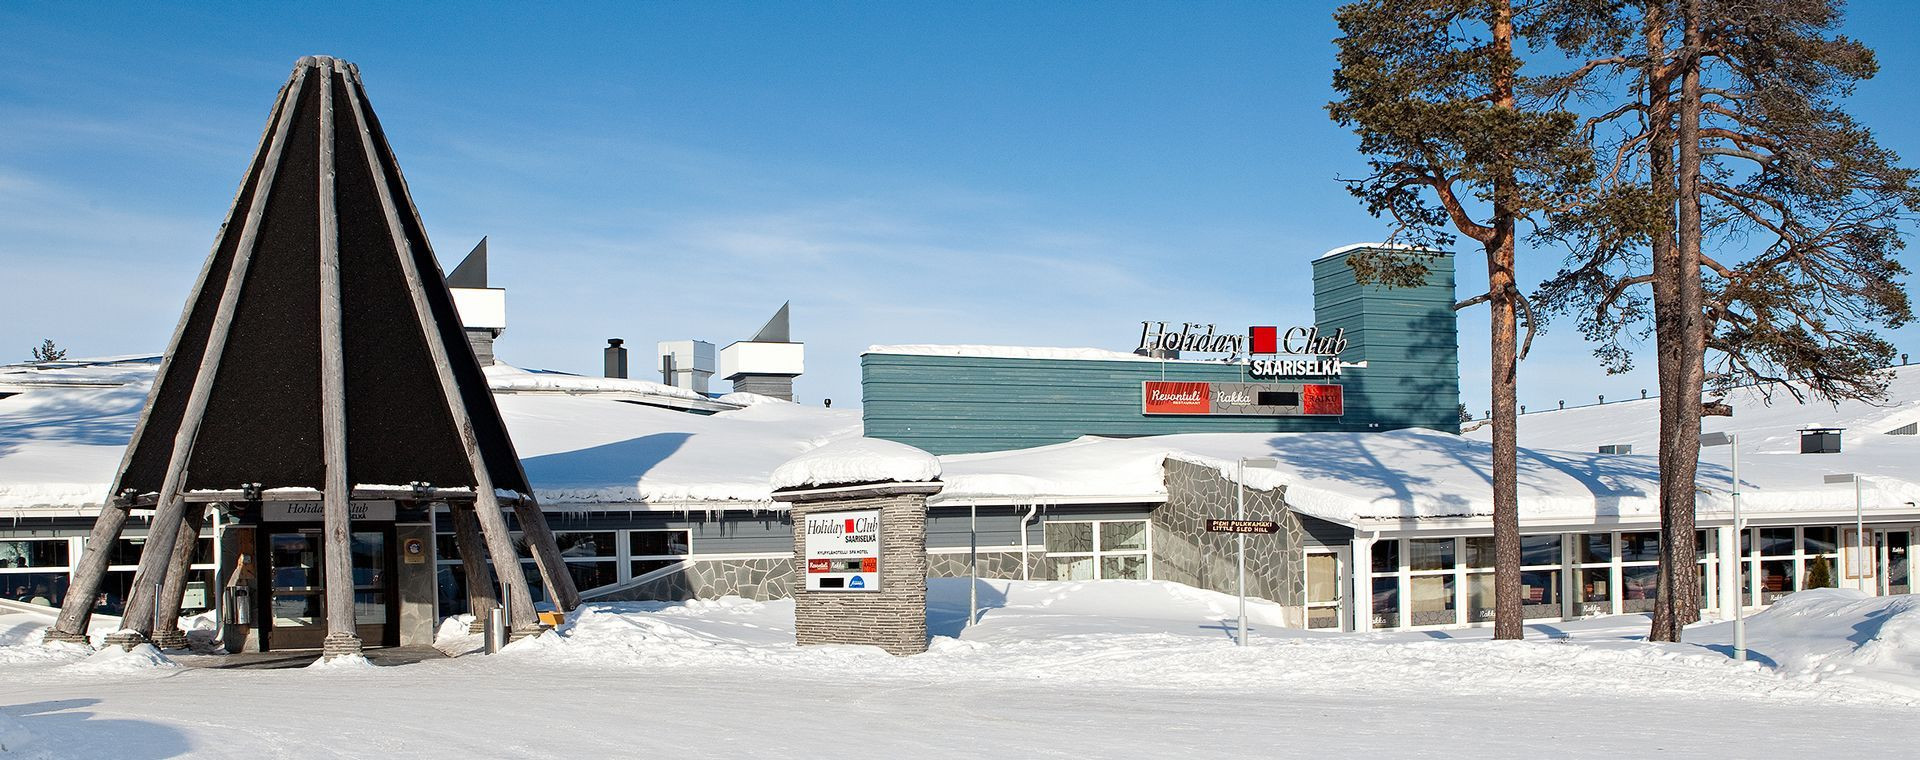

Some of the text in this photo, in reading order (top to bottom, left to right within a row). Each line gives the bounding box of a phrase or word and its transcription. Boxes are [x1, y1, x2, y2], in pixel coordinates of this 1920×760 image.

[1136, 321, 1348, 363] Holiday Club
[1251, 357, 1342, 377] SAARISELKÄ
[1152, 389, 1252, 403] Revontuli Rakka
[287, 502, 325, 517] Holida
[807, 516, 878, 538] Holiday Club
[845, 534, 877, 543] SAARISELKÄ
